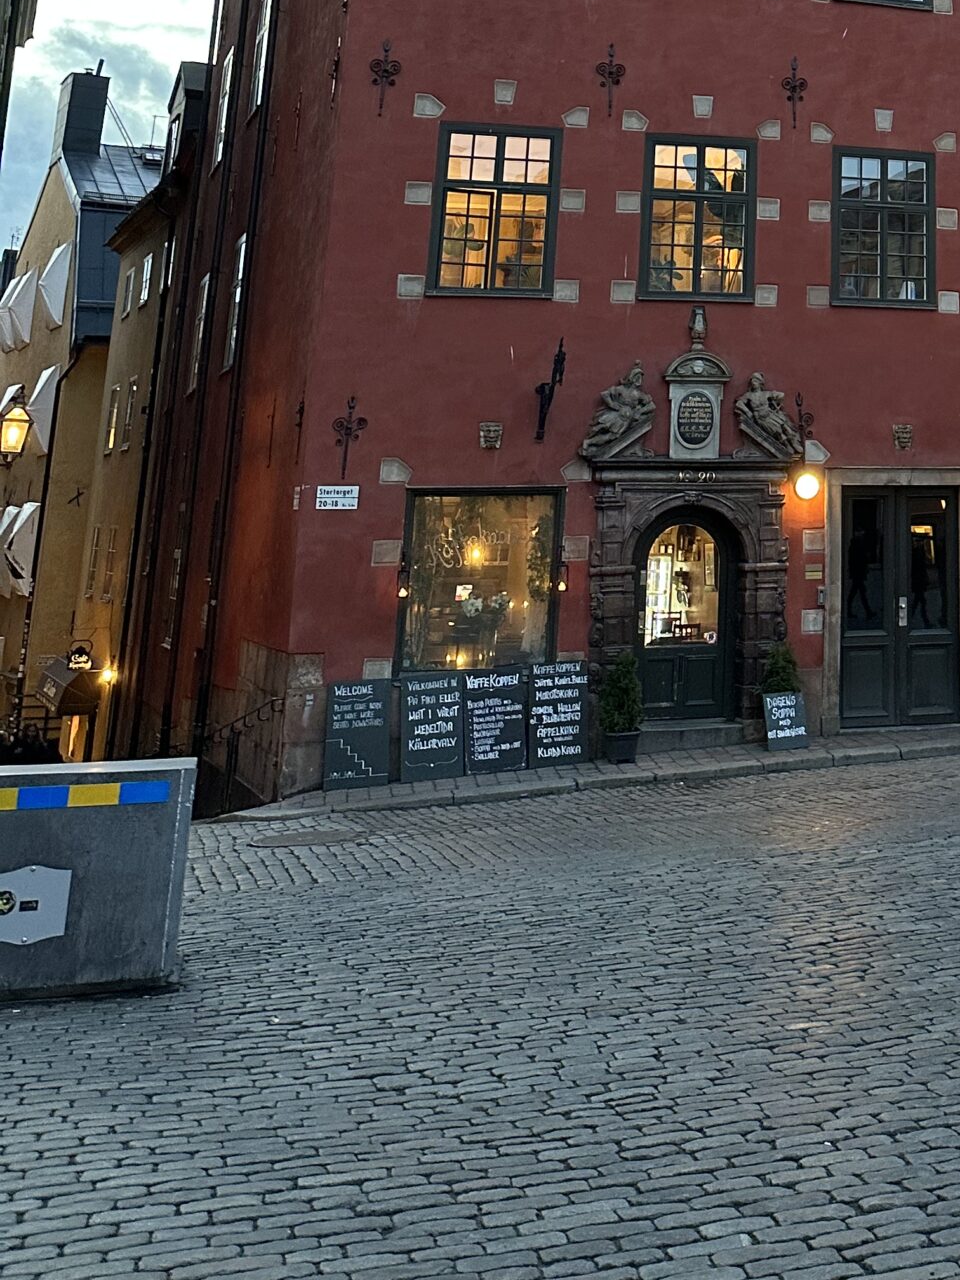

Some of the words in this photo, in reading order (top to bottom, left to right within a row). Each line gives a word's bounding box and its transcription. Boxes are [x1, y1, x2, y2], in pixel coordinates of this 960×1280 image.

[697, 472, 716, 483] 20
[334, 685, 373, 696] WELCOME
[536, 689, 579, 701] MOROTSKAKA
[440, 692, 460, 703] ELLER
[766, 695, 796, 710] DAGENS
[409, 708, 425, 721] MAT
[772, 708, 796, 720] SOPPA
[415, 721, 453, 735] MEDELTIDA
[537, 725, 580, 738] ÄPPELKAKA
[409, 737, 457, 751] KÄLLARVALV
